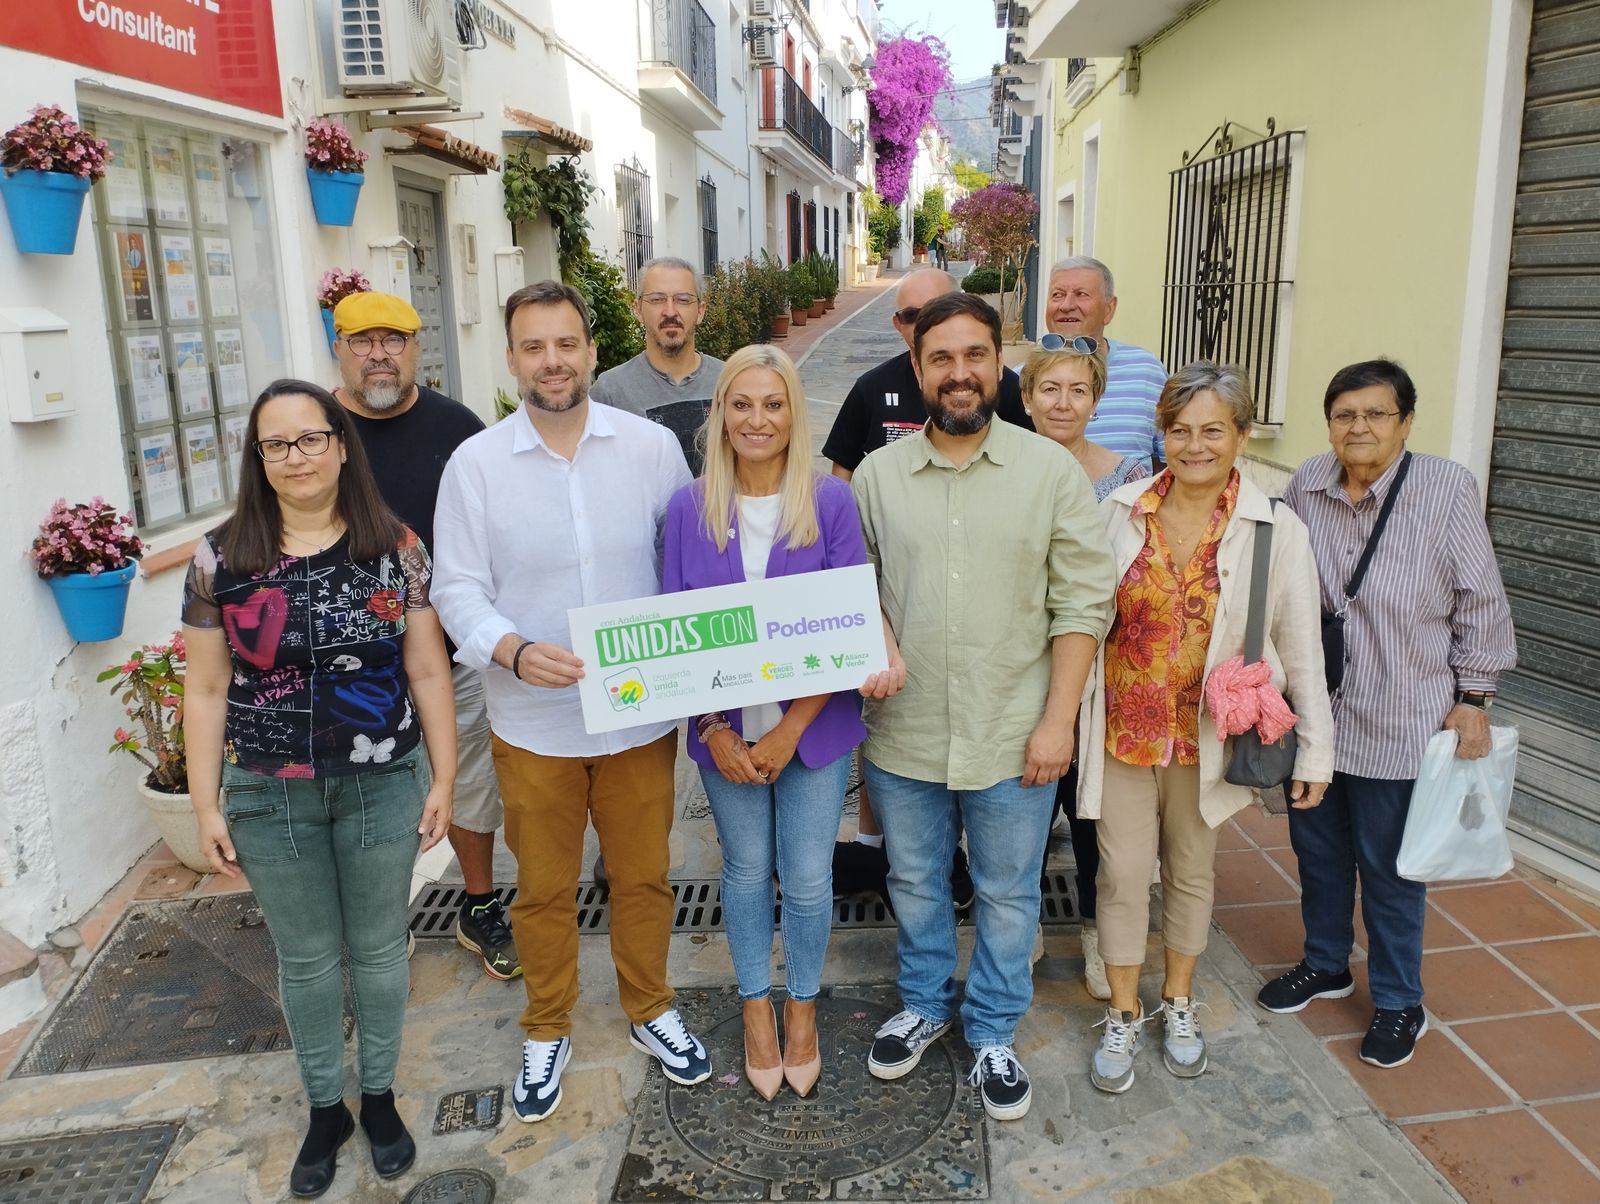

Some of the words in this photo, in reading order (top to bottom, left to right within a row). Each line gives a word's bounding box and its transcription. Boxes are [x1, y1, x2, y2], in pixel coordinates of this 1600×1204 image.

[77, 0, 197, 56] Consultant
[340, 625, 369, 639] YOU
[766, 612, 866, 640] Podemos
[600, 616, 703, 664] UNIDAS
[709, 609, 754, 646] CON
[845, 652, 870, 662] Alianza
[846, 660, 866, 668] Verde
[775, 671, 795, 680] EQUO
[654, 680, 679, 692] unida
[759, 1122, 854, 1141] PLUVIALES
